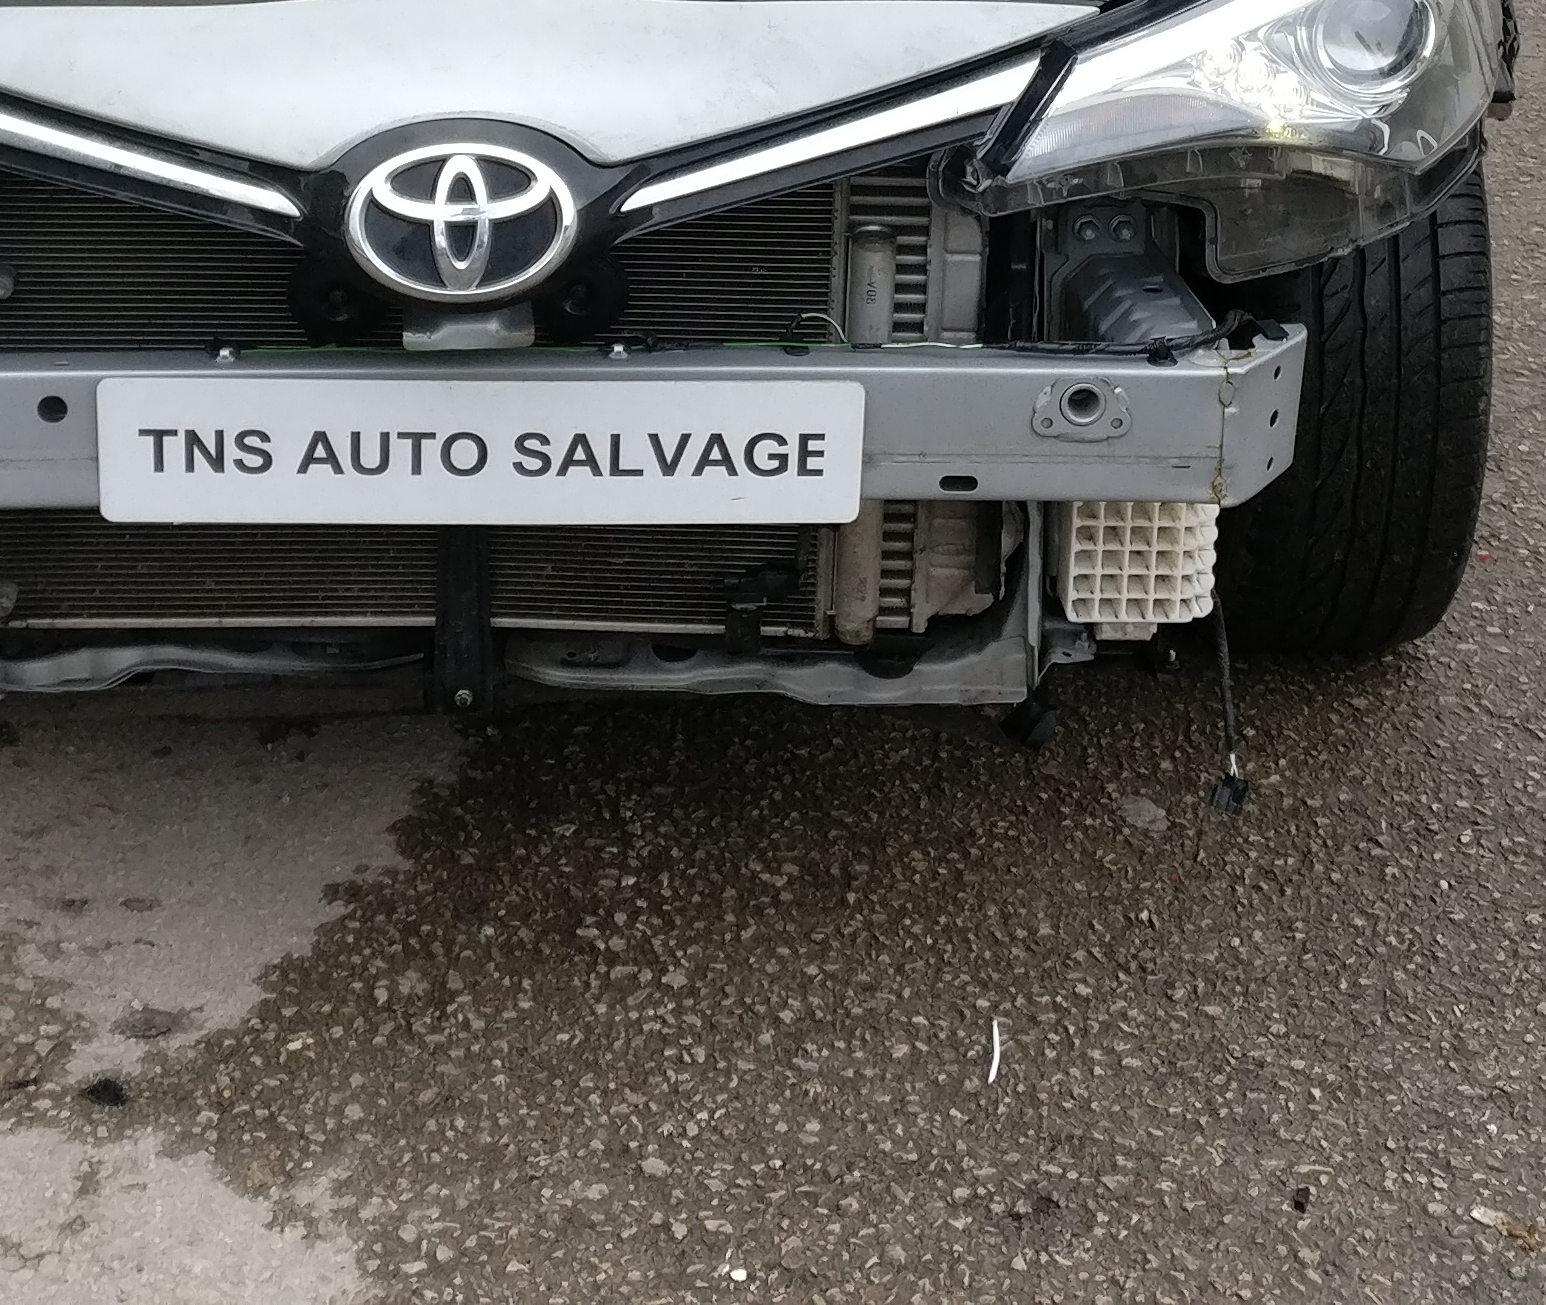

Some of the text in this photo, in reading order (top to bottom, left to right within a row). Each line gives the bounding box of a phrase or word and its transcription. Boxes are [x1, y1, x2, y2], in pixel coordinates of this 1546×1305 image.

[137, 427, 827, 479] TNS AUTO SALVAGE
